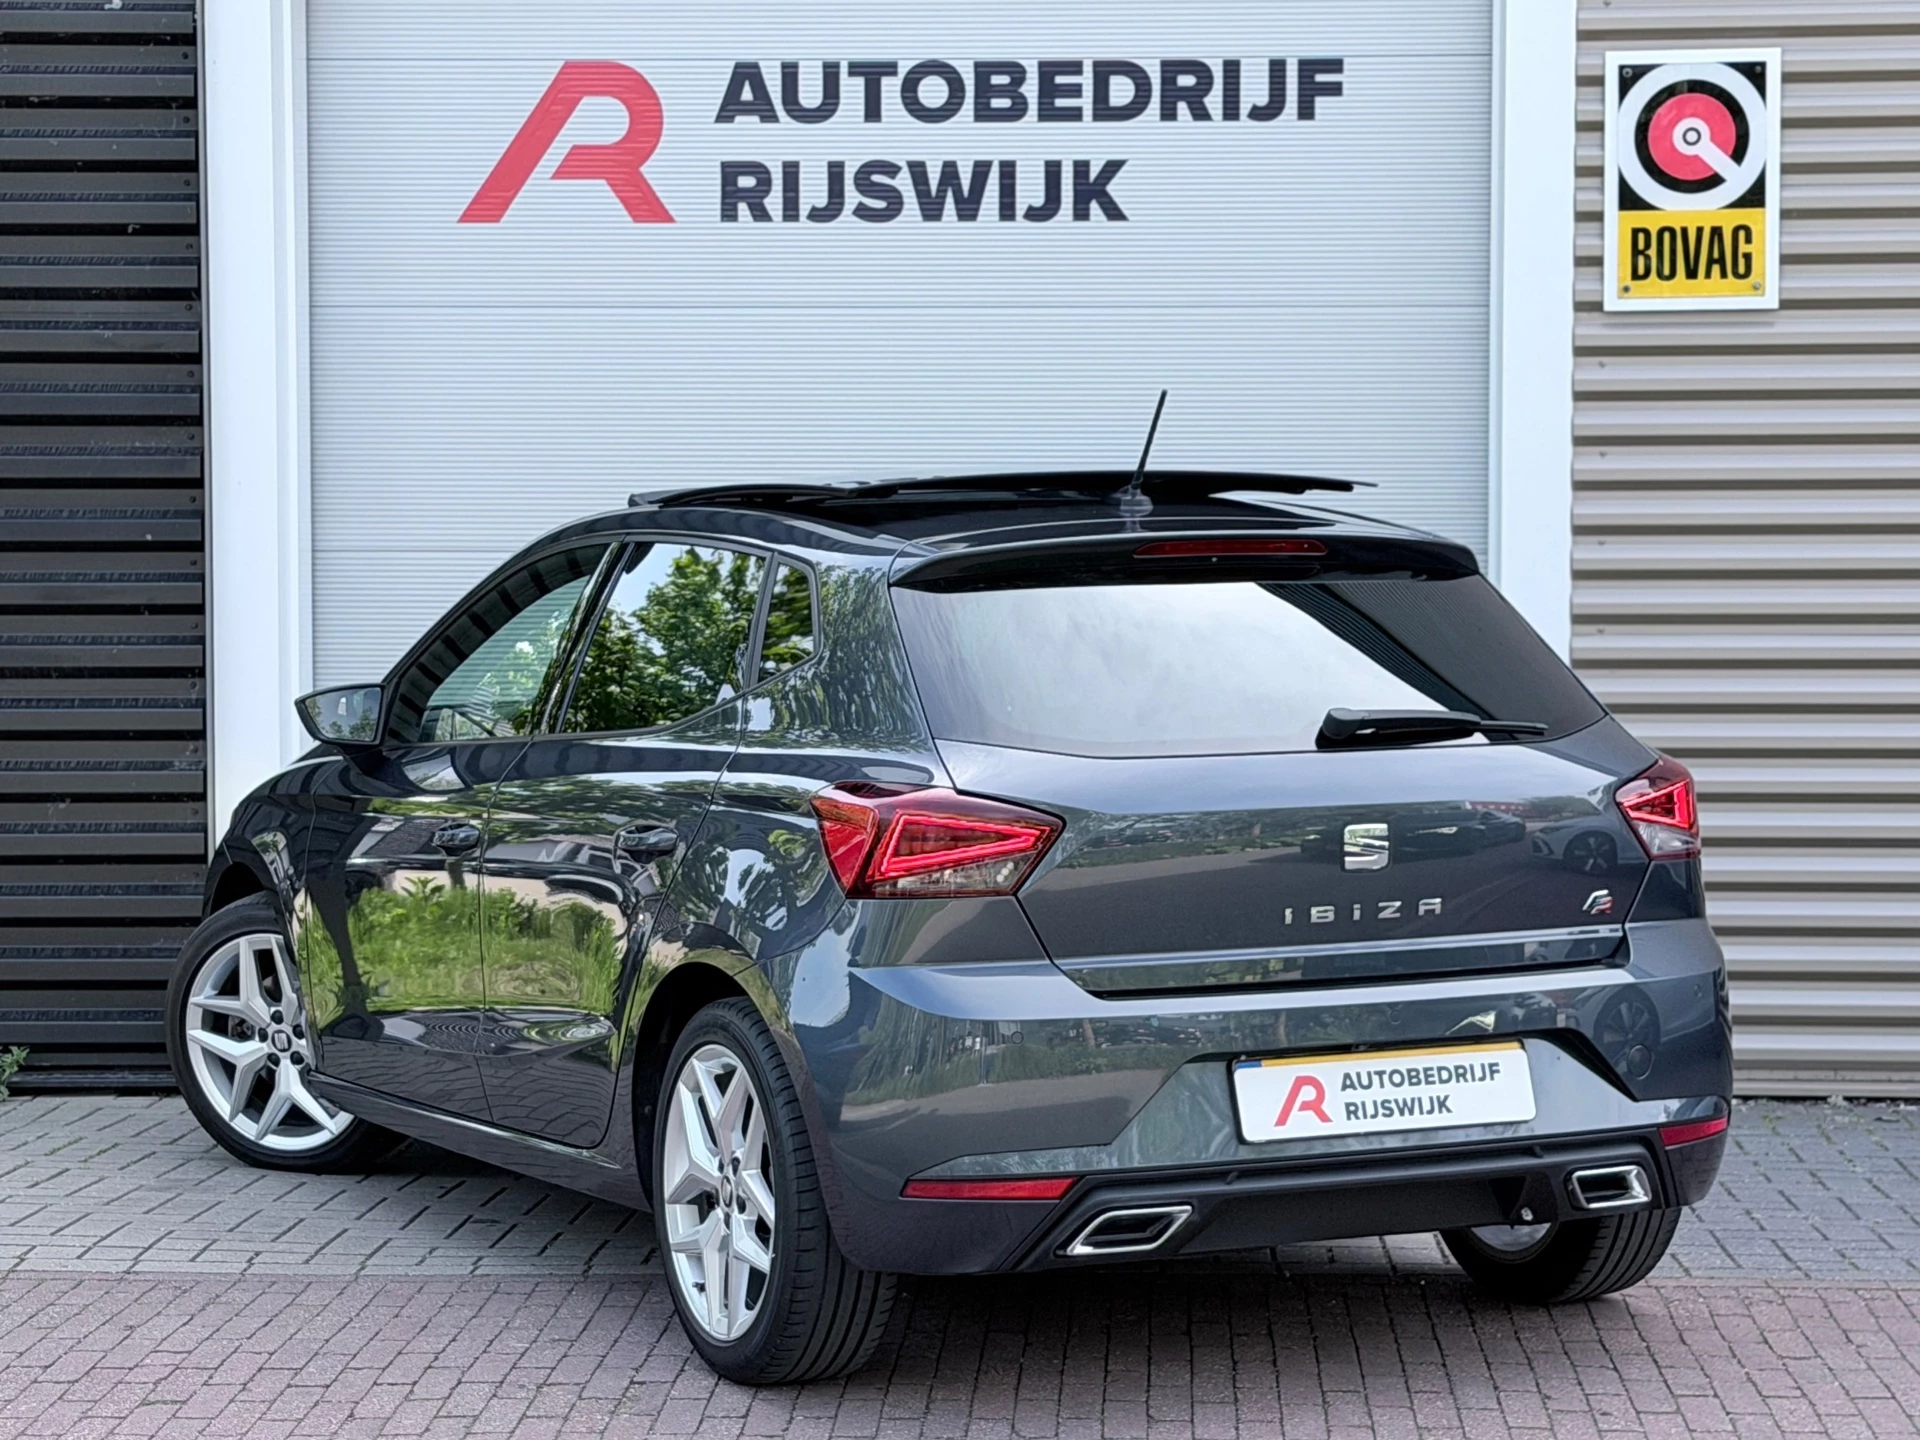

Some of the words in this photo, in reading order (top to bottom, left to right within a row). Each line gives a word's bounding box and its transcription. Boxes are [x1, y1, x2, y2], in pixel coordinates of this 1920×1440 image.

[714, 57, 1344, 123] AUTOBEDRIJF
[720, 159, 1128, 222] RIJSWIJK
[1631, 224, 1753, 280] BOVAG
[1284, 897, 1443, 925] IBIZA
[1340, 1062, 1501, 1092] AUTOBEDRIJF
[1344, 1095, 1453, 1121] RIJSWIJK
